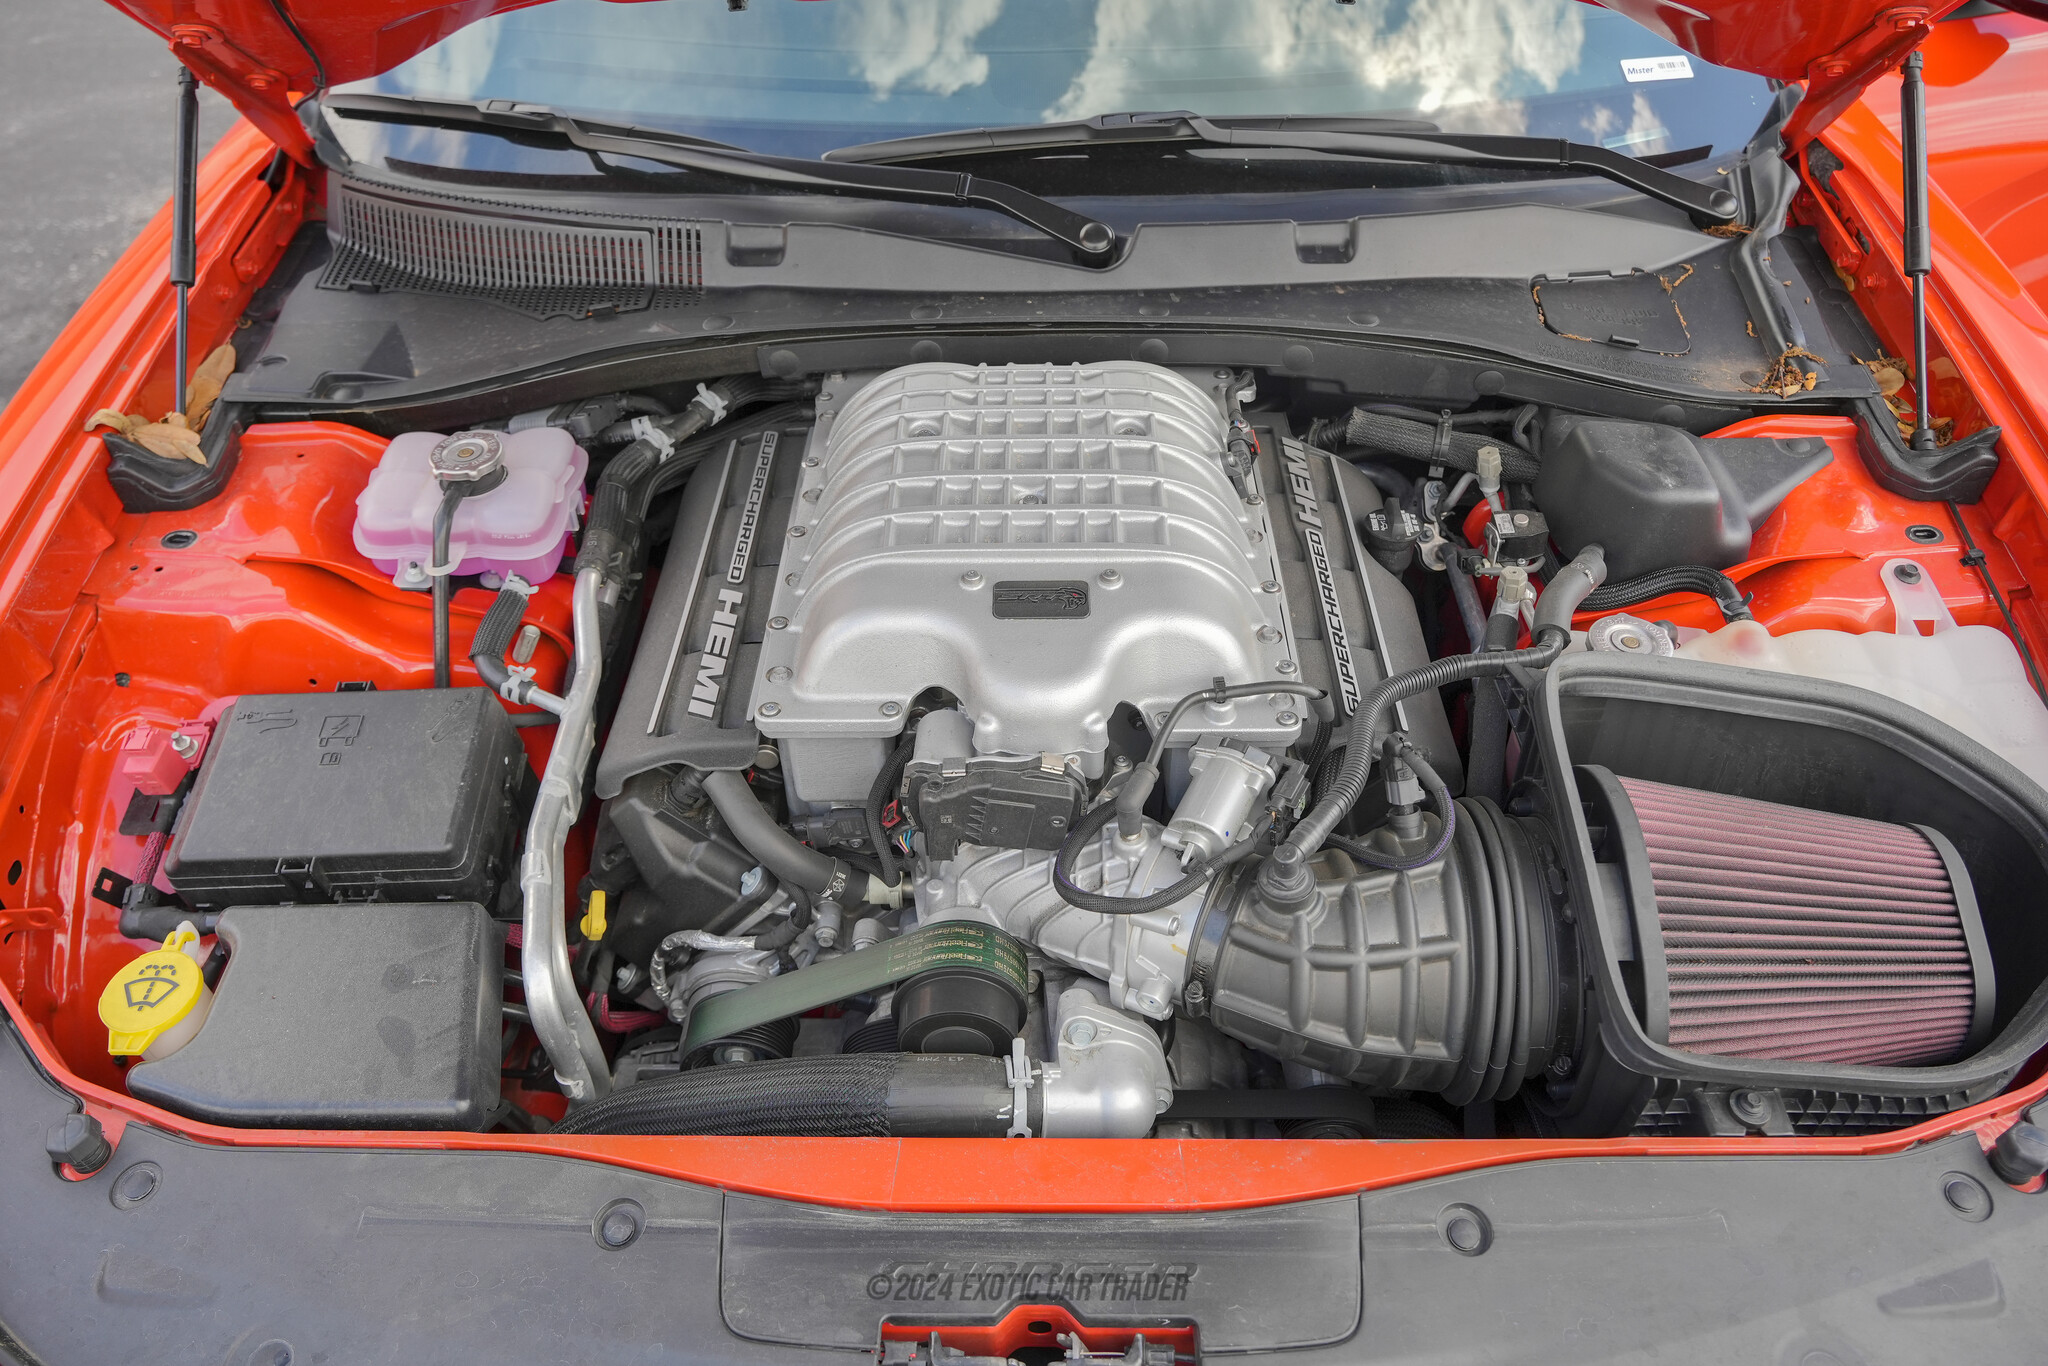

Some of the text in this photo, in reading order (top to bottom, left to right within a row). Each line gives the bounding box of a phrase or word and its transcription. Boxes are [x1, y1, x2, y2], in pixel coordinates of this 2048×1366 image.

[1627, 67, 1654, 75] Mister
[688, 431, 778, 719] SUPERCHARGED HEMI
[1281, 437, 1361, 715] SUPERCHARGED HEMI
